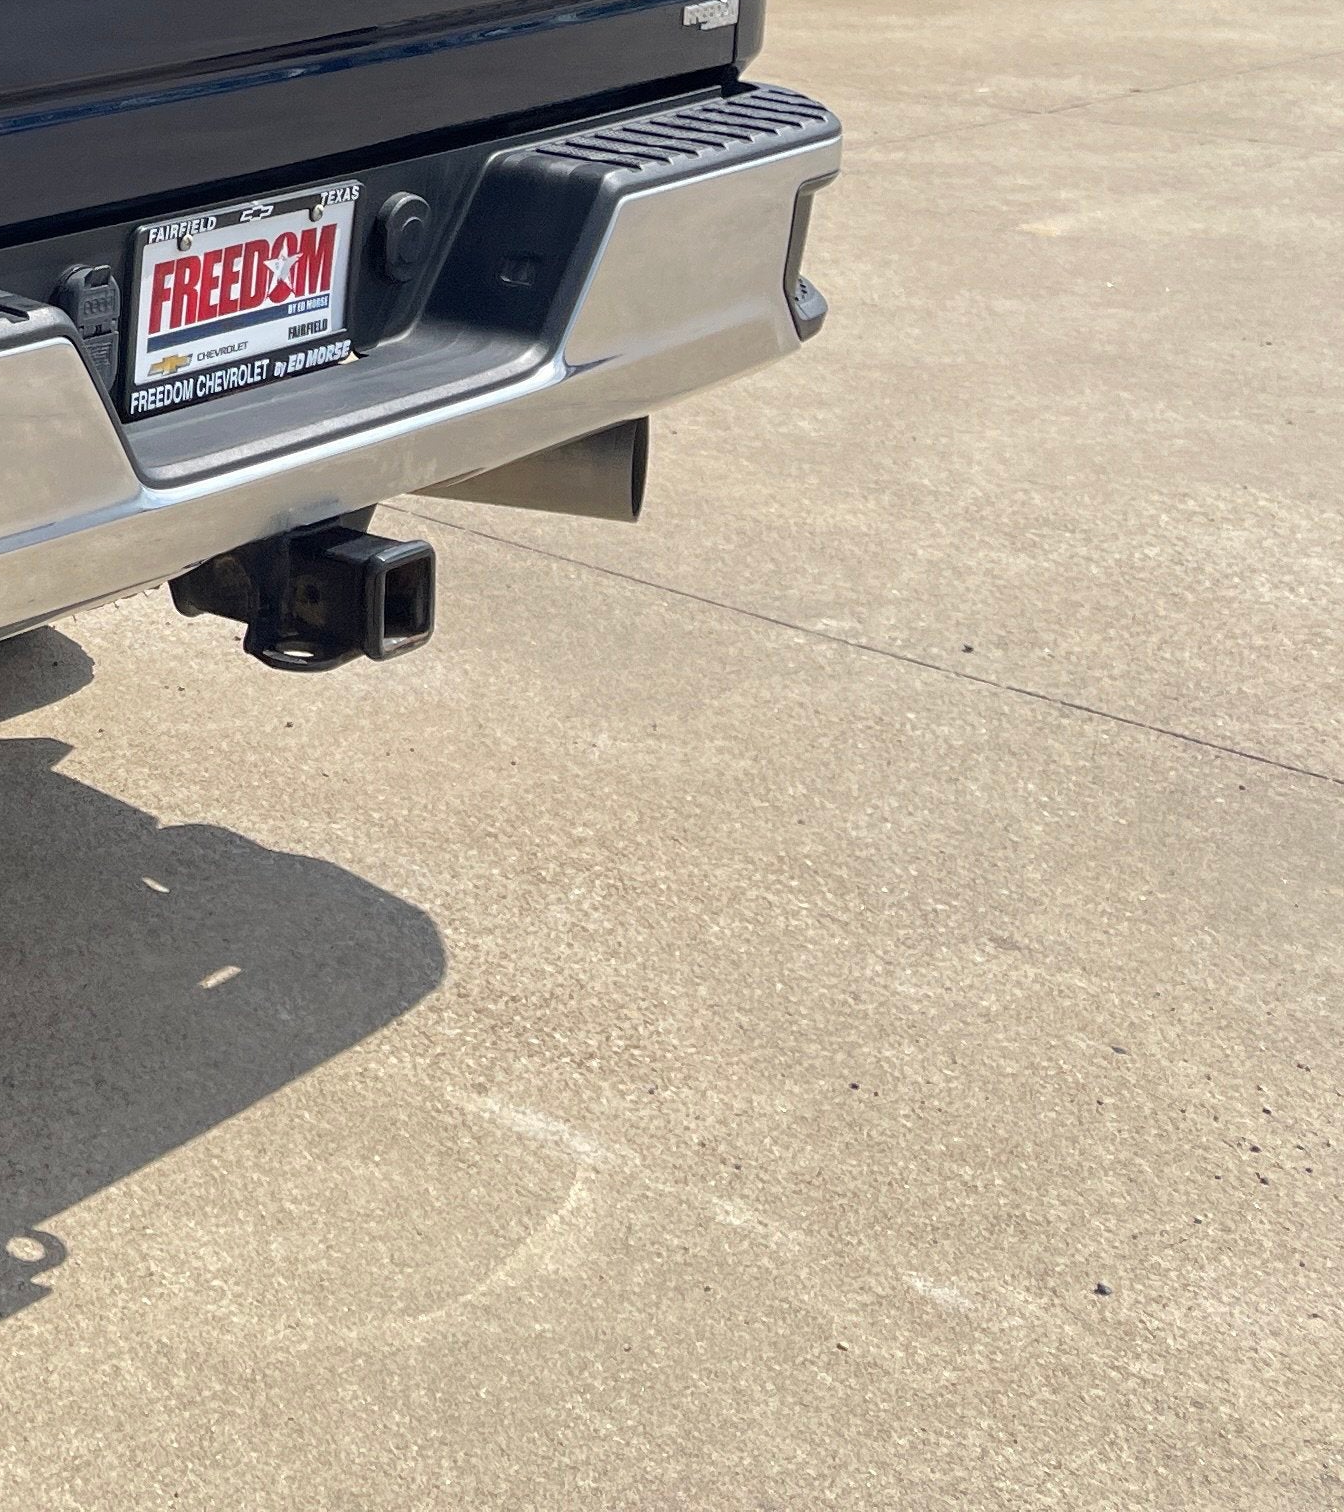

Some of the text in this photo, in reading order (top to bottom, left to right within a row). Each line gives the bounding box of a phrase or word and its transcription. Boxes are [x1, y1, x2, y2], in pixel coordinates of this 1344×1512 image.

[320, 185, 360, 206] TEXAS
[148, 216, 217, 244] FAIRFIELD
[148, 223, 338, 336] FREEDOM
[287, 295, 329, 315] BY ED MORSE
[287, 319, 328, 340] FAIRFIELD
[197, 341, 249, 361] CHEVROLET
[130, 378, 194, 415] FREEDOM
[196, 357, 269, 397] CHEVROLET
[287, 352, 305, 373] ED
[306, 339, 351, 368] MORSE
